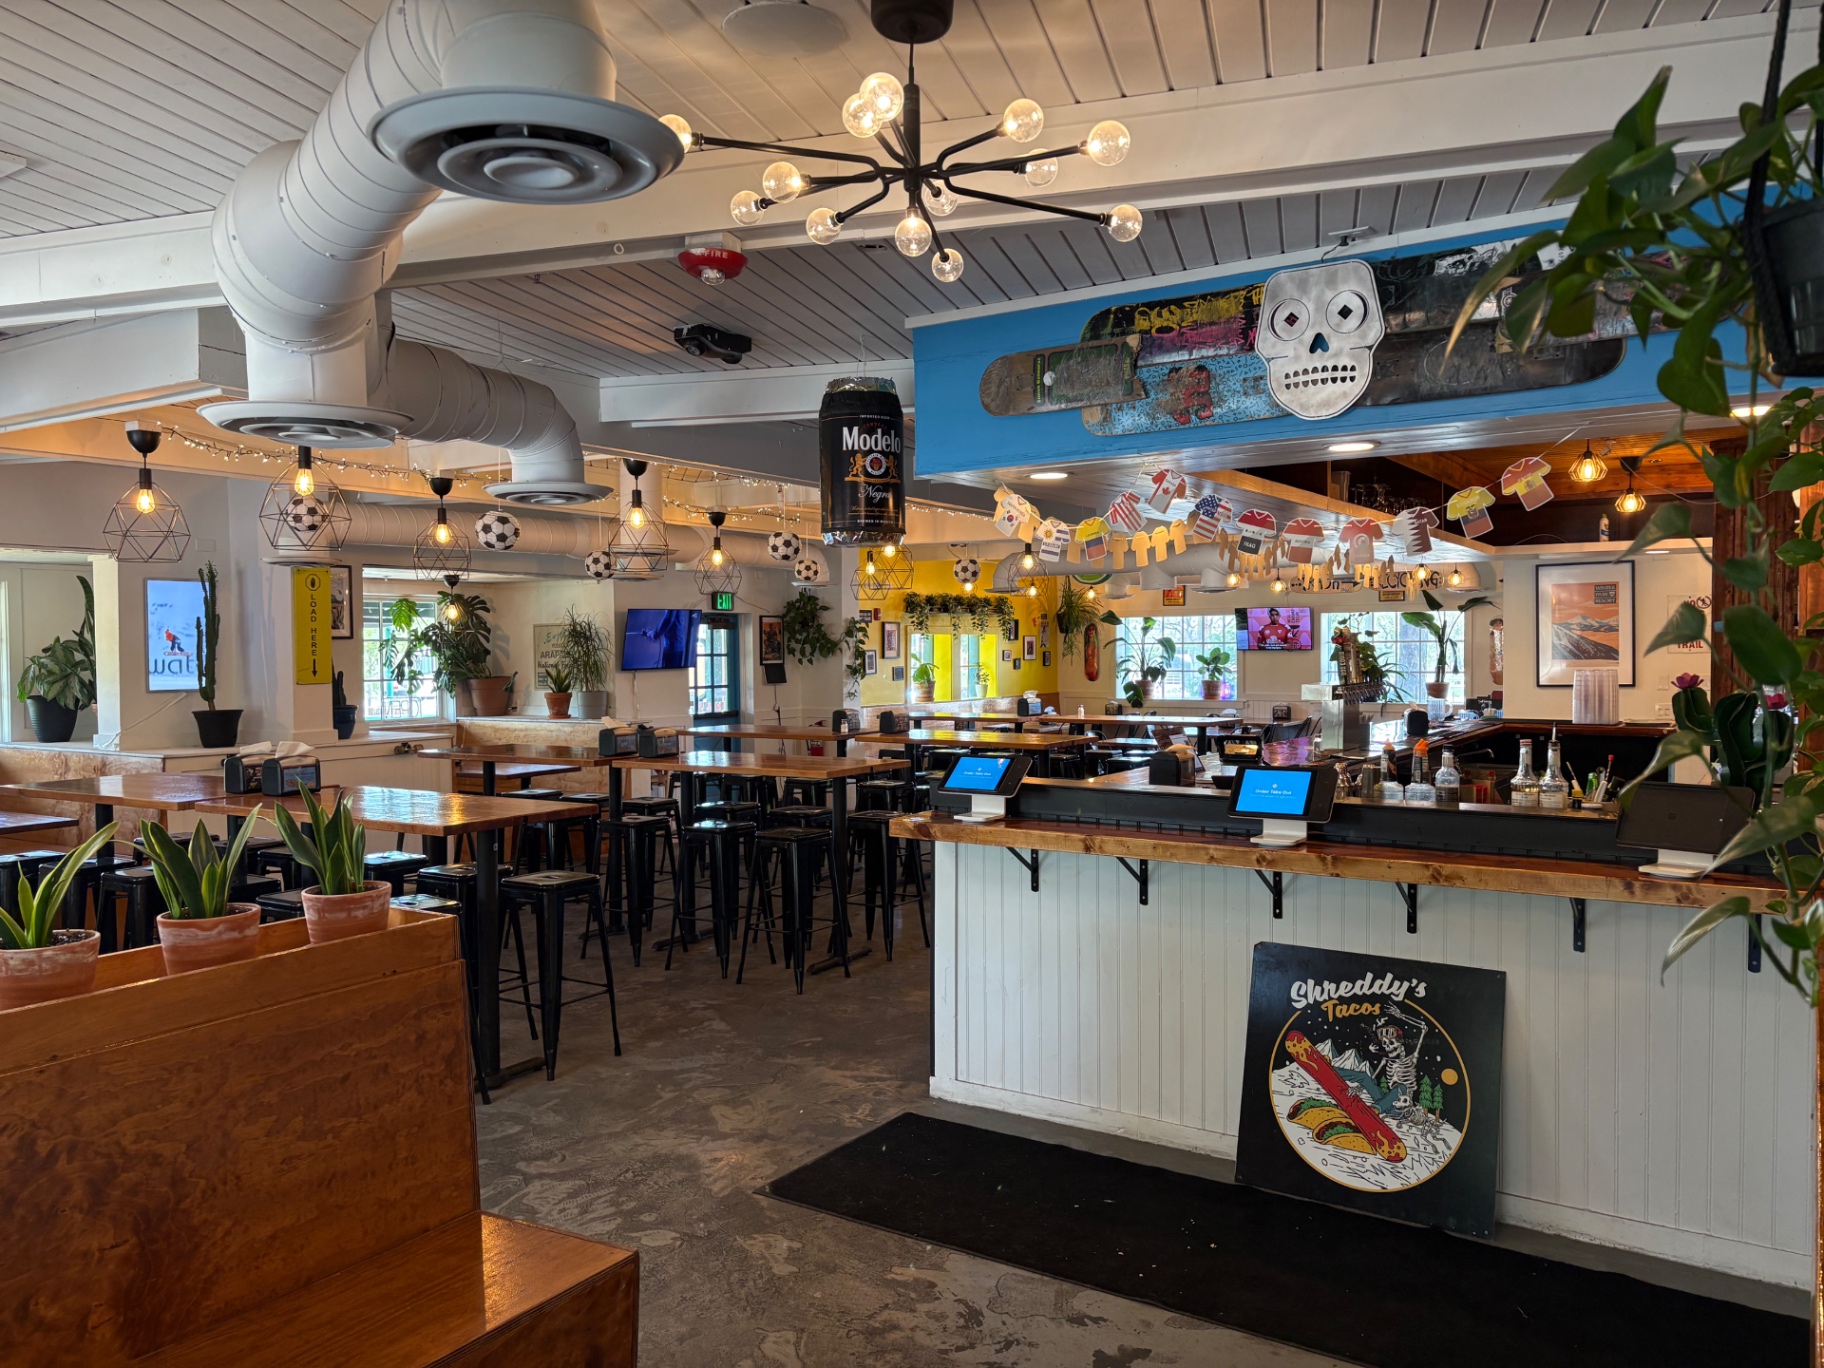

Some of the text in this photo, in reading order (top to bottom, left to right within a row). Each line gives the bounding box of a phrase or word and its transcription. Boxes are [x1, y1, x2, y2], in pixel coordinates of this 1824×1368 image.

[704, 249, 729, 259] FIRE
[842, 426, 901, 454] Modelo
[858, 482, 892, 504] Negra
[1242, 540, 1257, 549] IRAQ
[717, 592, 732, 610] EXIT
[310, 628, 318, 656] HERE
[1290, 971, 1427, 1009] Shreddy's
[1321, 999, 1381, 1022] Tacos
